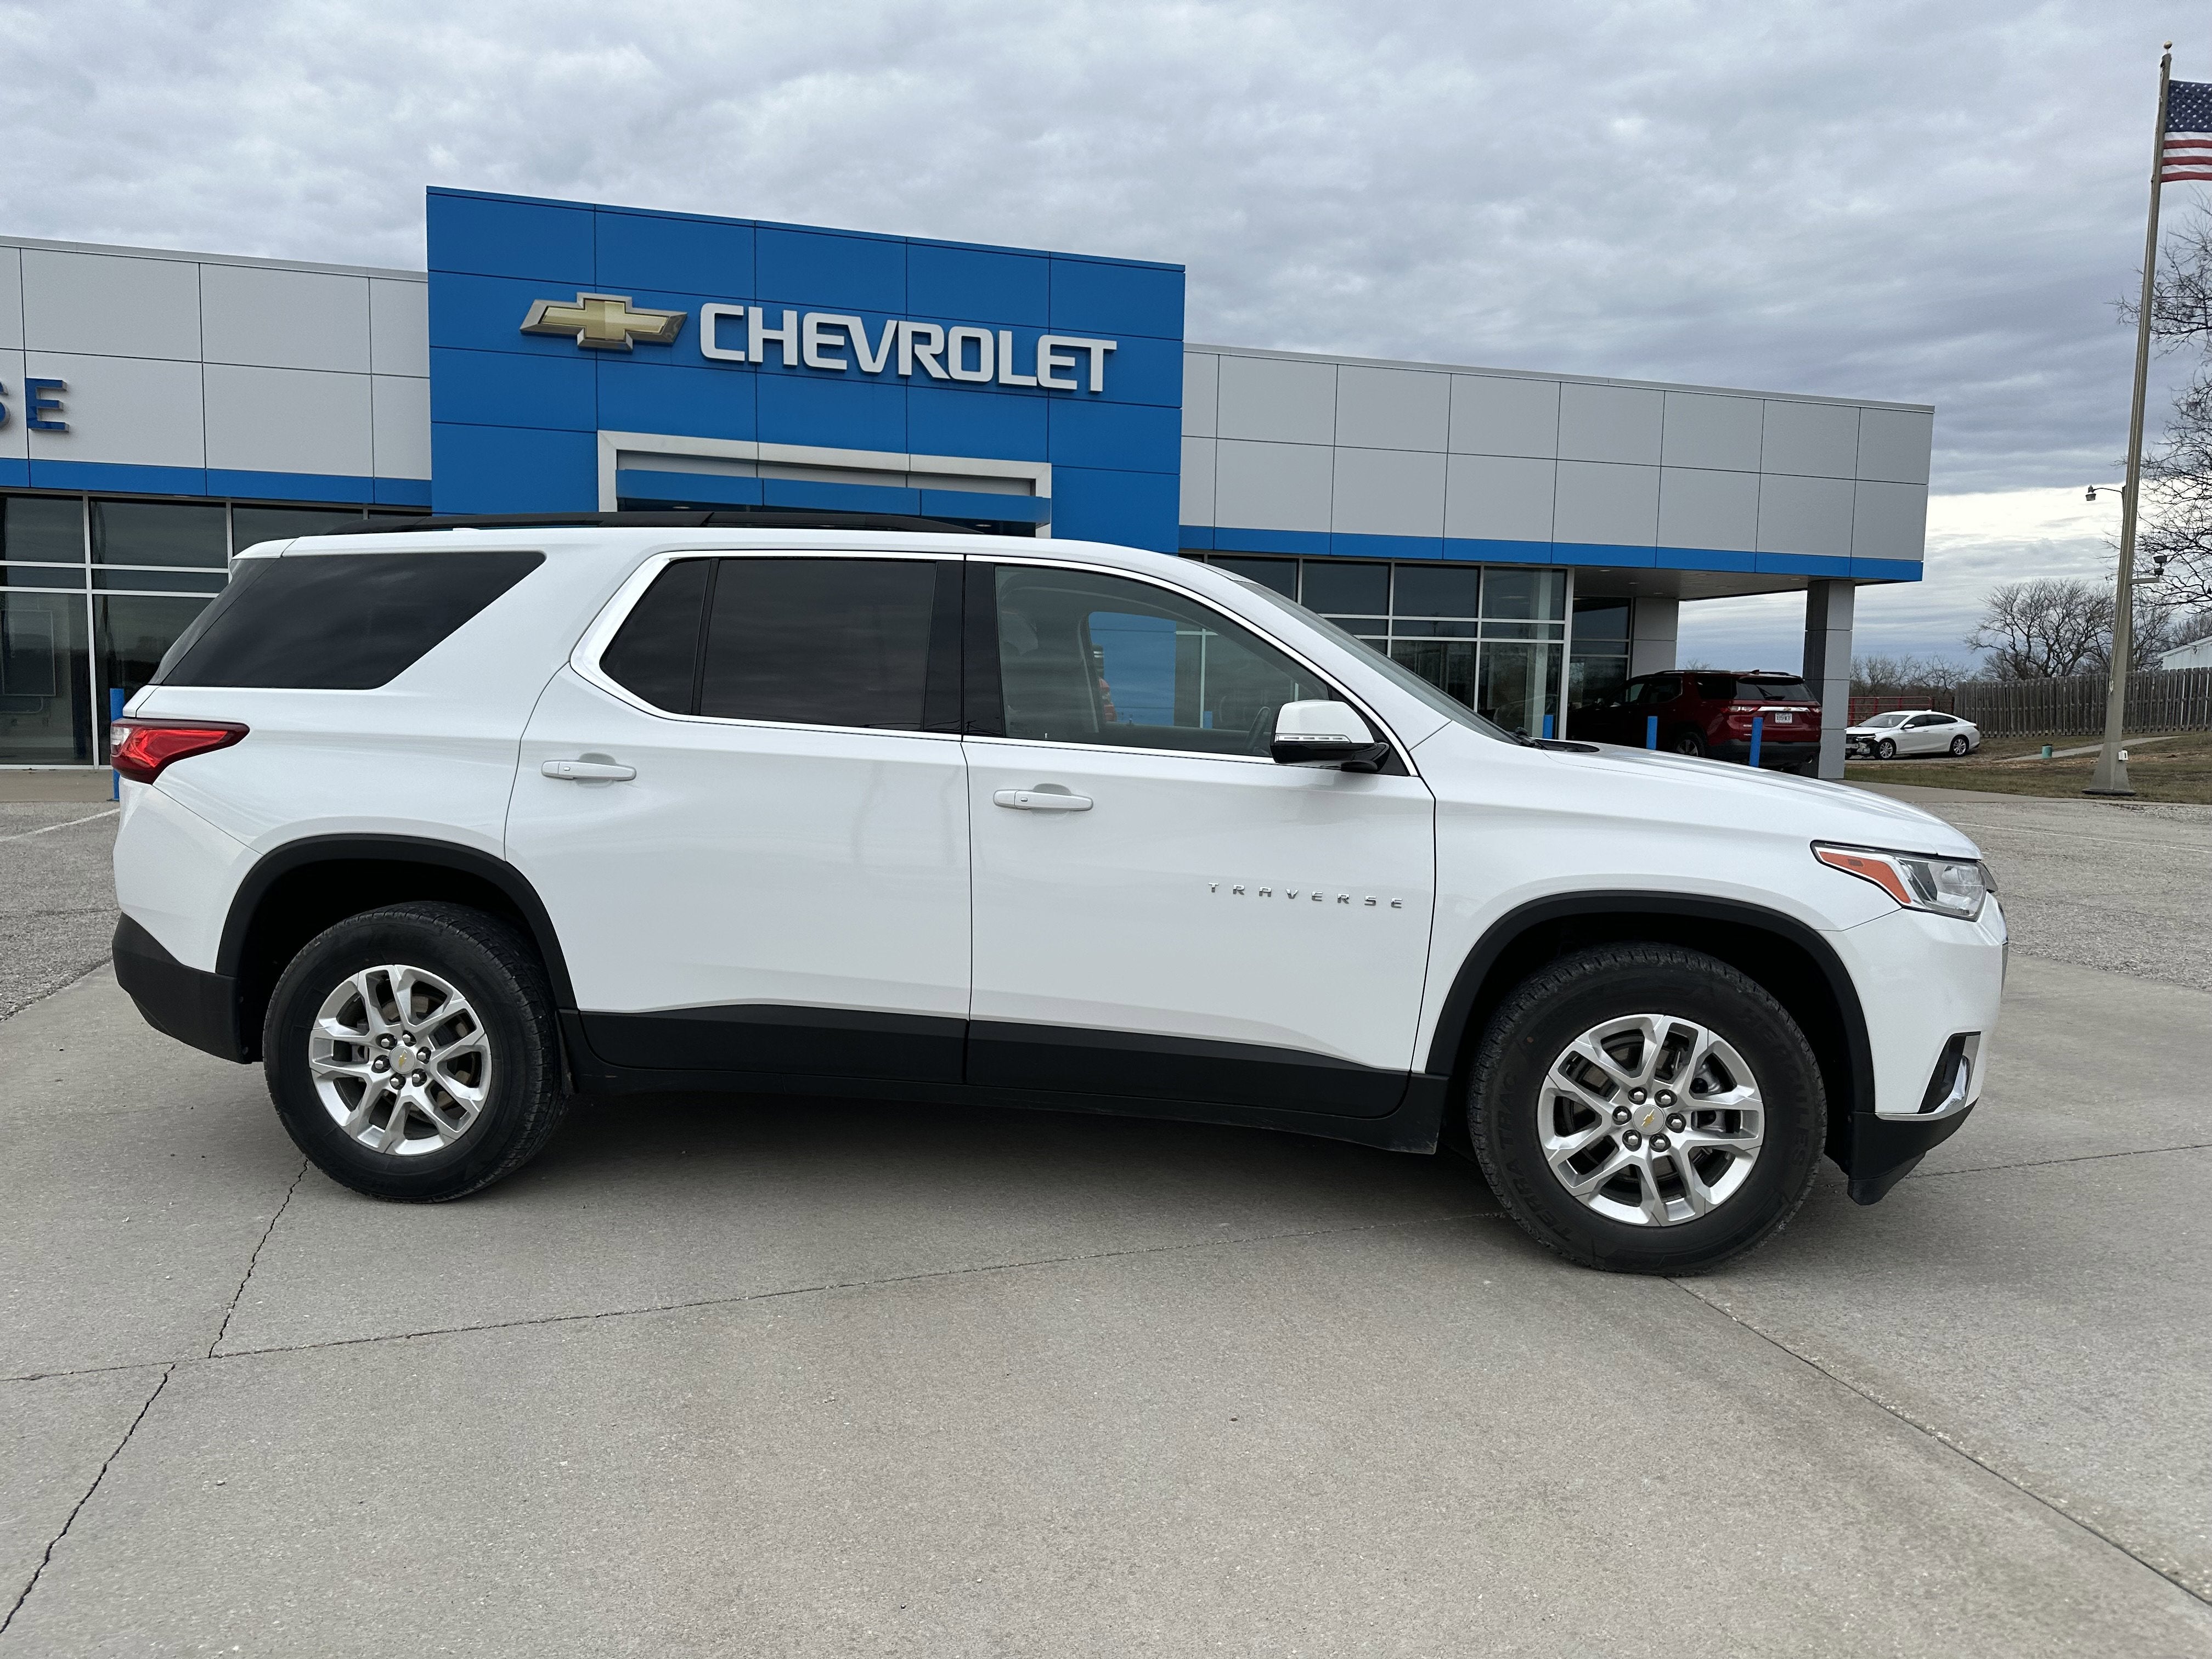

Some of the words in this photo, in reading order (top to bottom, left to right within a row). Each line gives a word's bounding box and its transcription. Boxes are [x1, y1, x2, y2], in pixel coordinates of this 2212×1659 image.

[701, 302, 1117, 392] CHEVROLET
[1208, 882, 1402, 909] TRAVERSE
[1498, 1071, 1517, 1149] TRAC
[1506, 1158, 1573, 1242] TERRA
